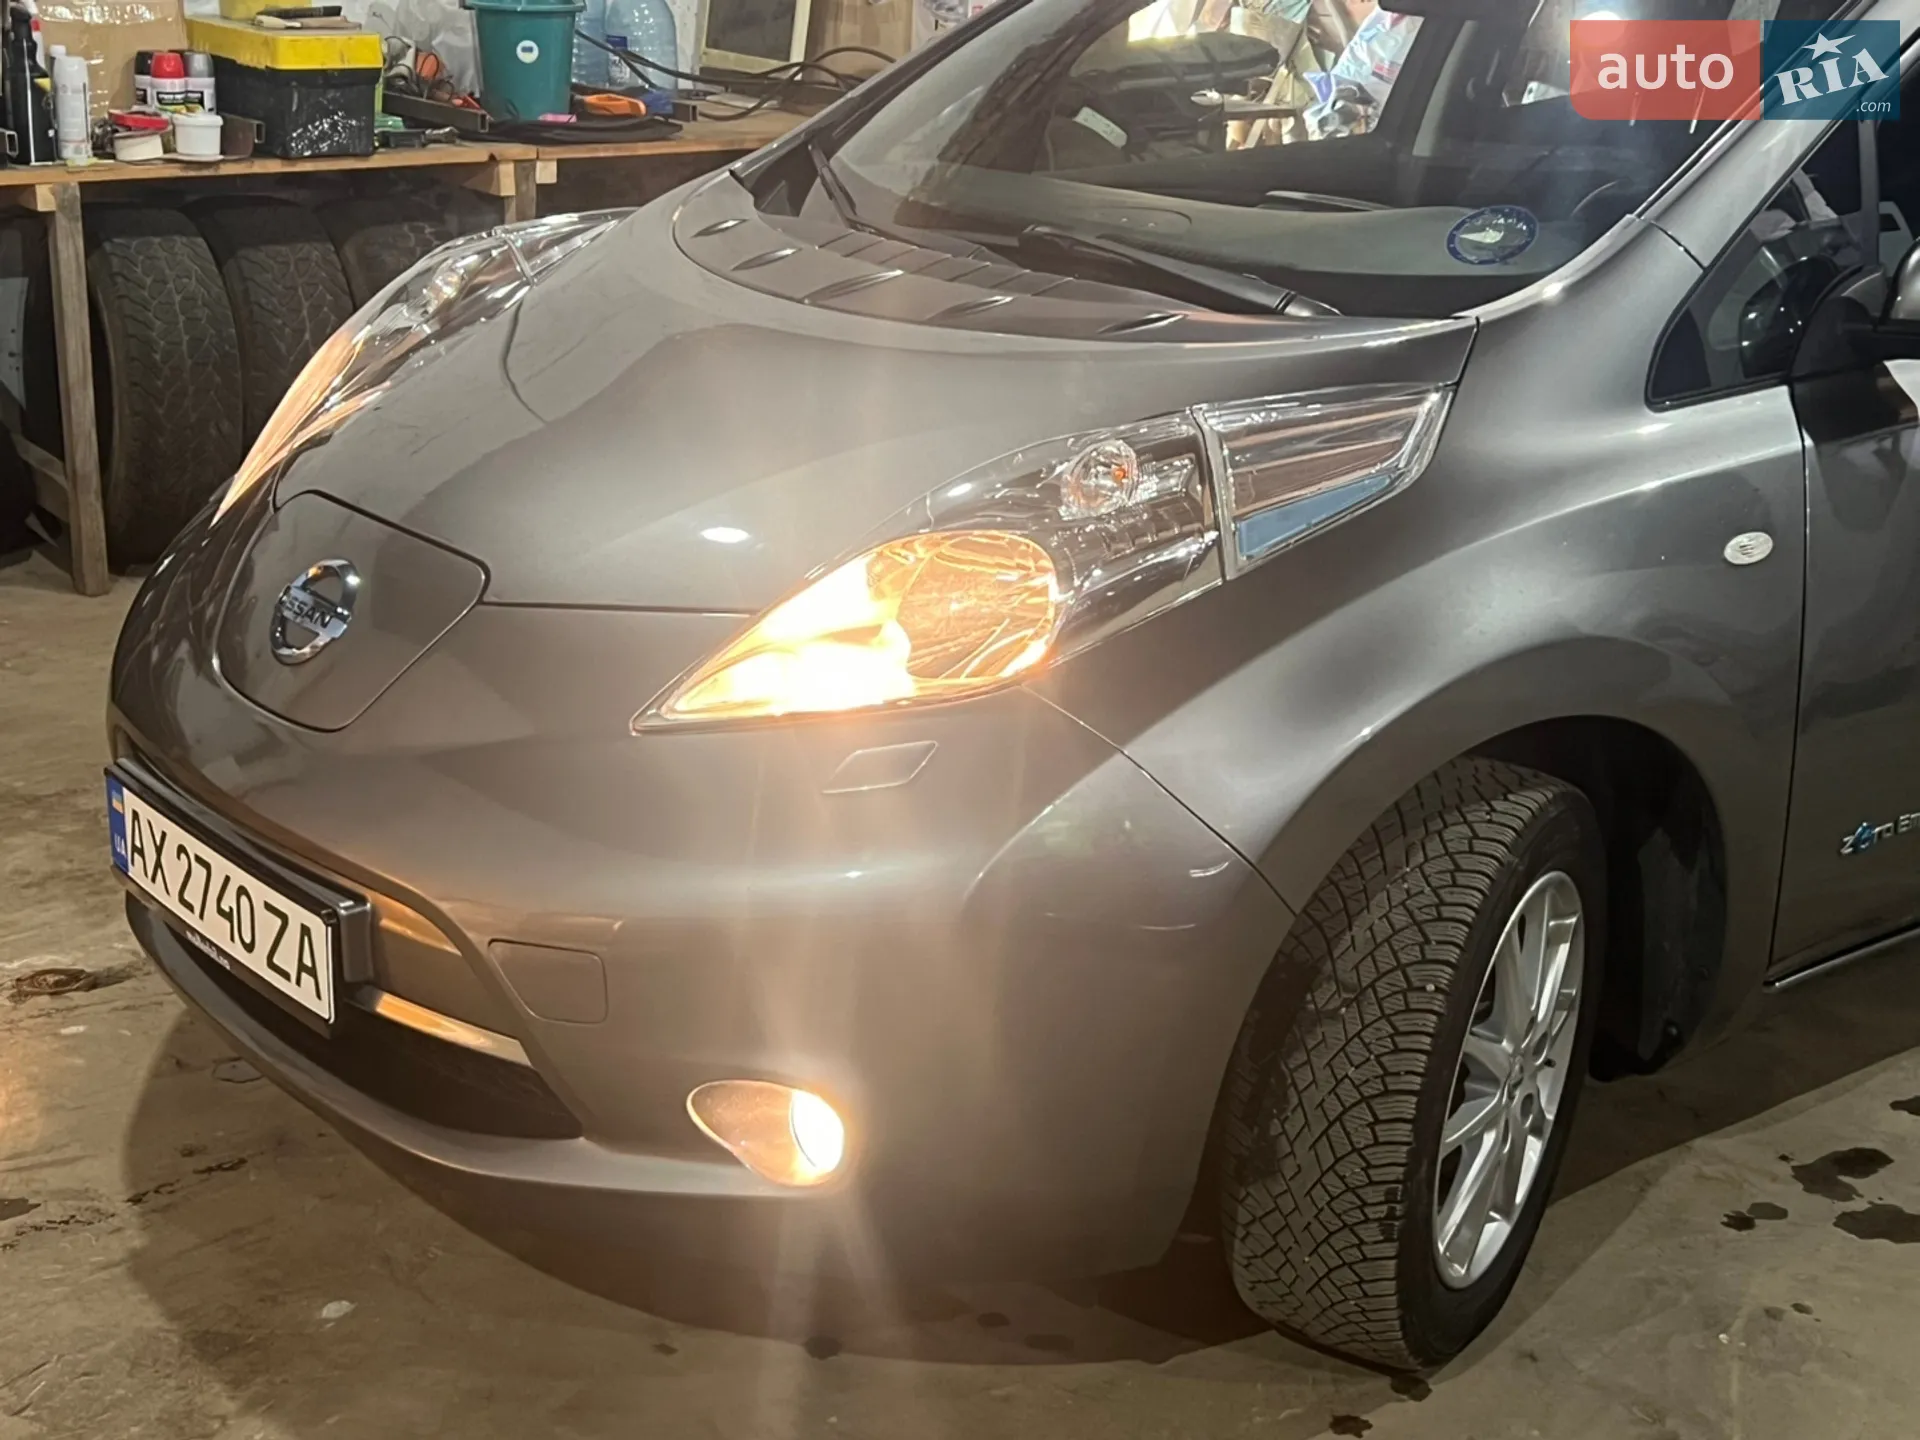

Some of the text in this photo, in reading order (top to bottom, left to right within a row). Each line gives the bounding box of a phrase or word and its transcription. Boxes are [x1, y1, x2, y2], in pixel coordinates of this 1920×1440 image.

[114, 833, 127, 857] UA
[131, 808, 170, 896] AX
[176, 844, 256, 954] 2740
[264, 900, 322, 1001] ZA
